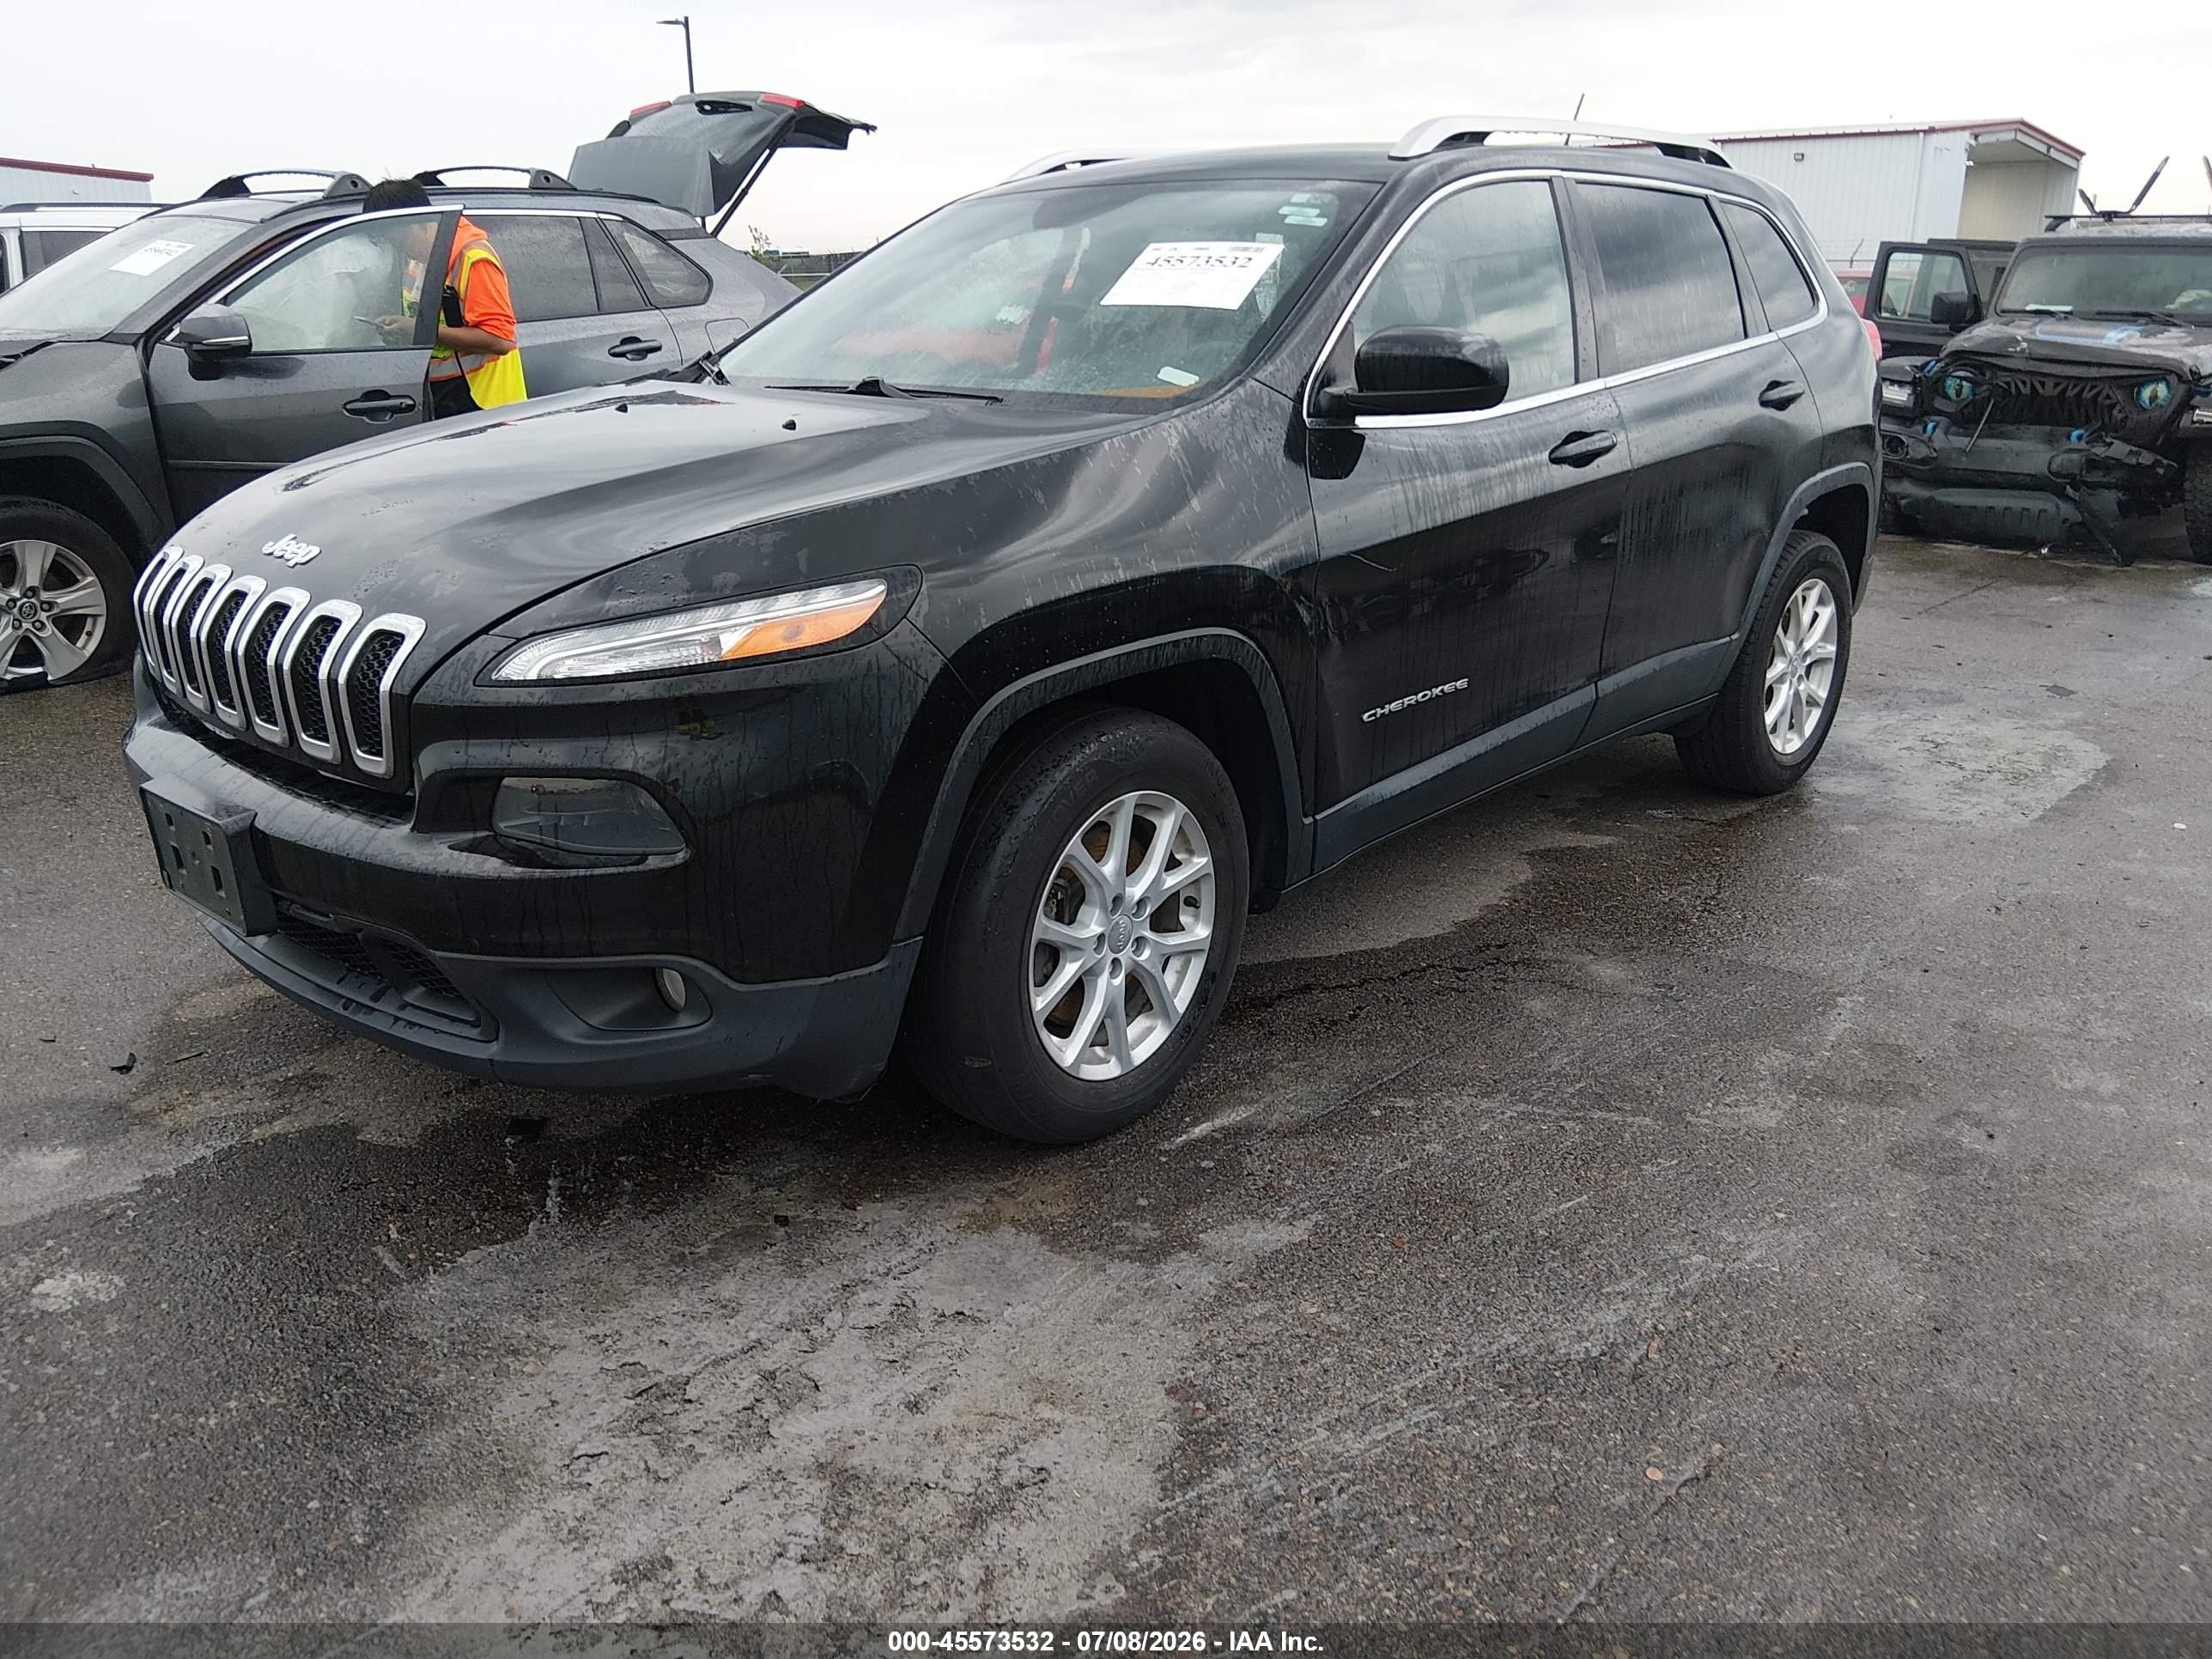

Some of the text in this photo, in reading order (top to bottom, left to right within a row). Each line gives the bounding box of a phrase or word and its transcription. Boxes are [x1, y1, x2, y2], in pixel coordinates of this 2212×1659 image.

[1146, 255, 1253, 269] 45573532
[261, 533, 321, 568] Jeep
[1363, 678, 1469, 722] CHEROKEE
